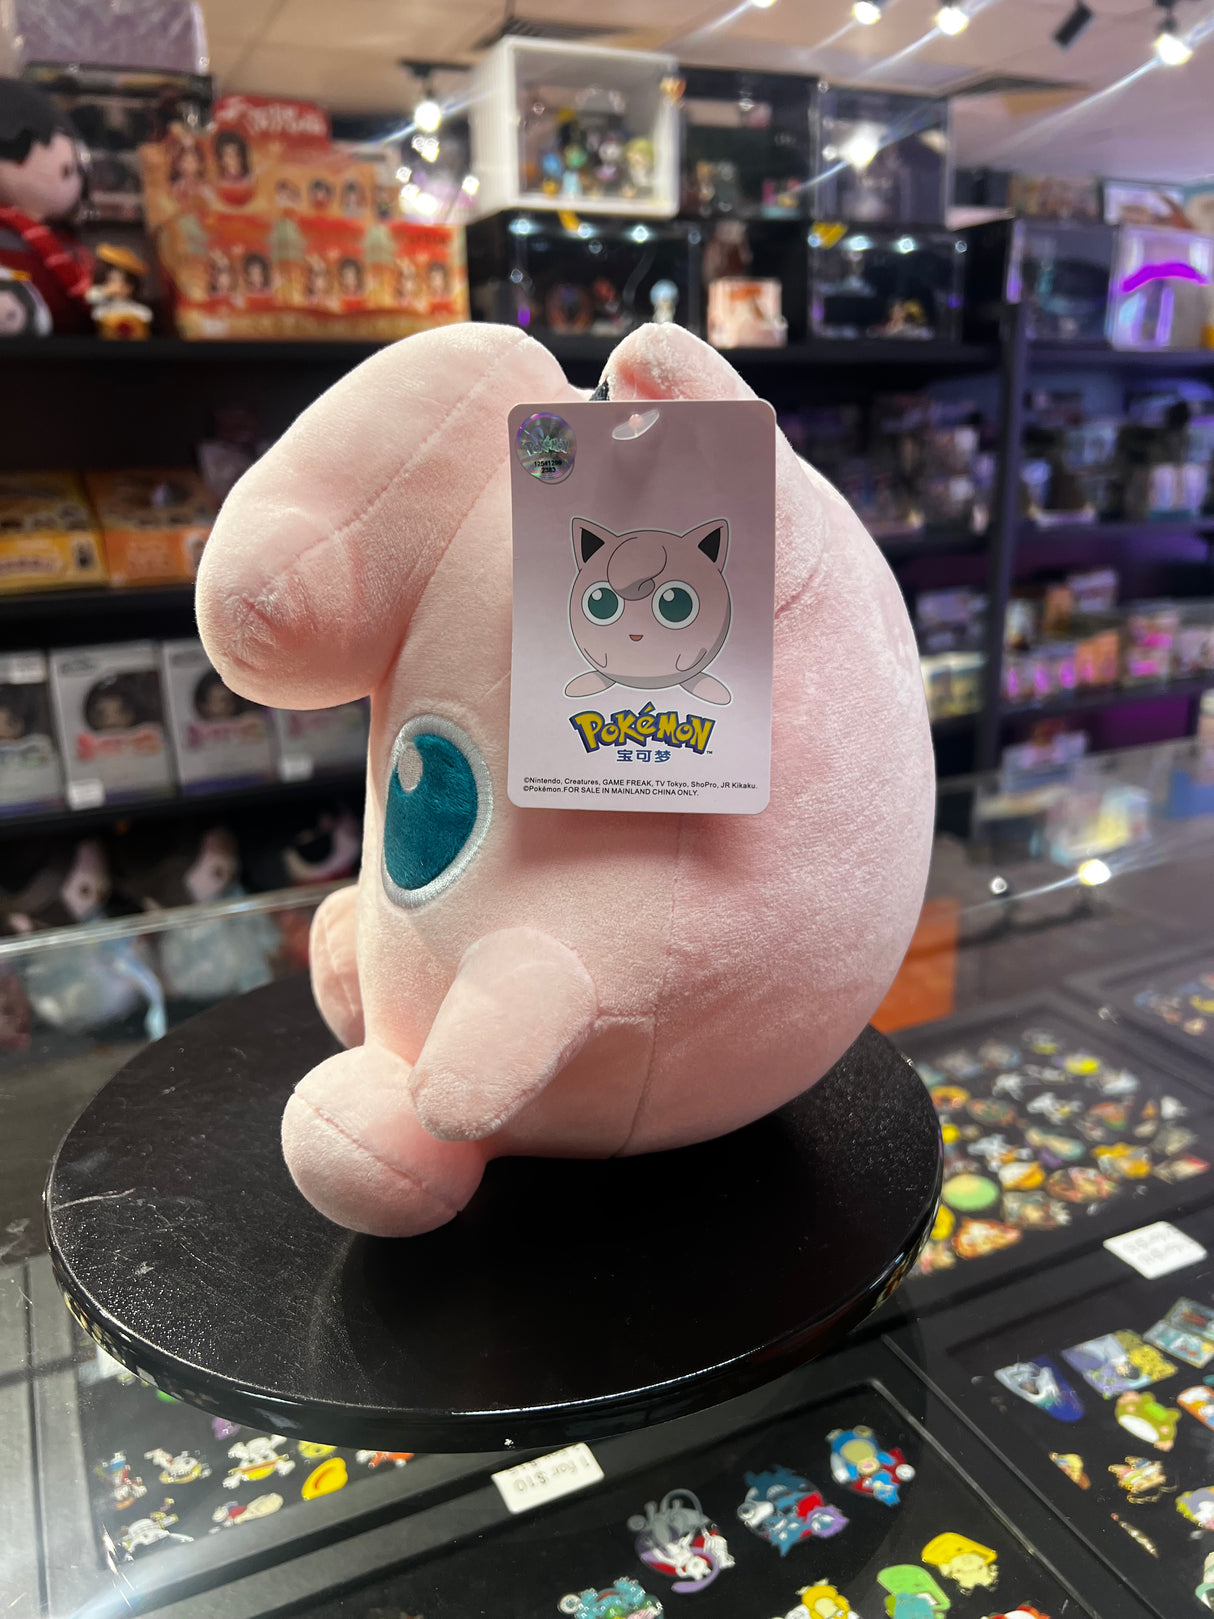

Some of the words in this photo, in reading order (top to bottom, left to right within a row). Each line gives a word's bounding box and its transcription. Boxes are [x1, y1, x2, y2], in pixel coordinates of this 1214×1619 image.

[616, 750, 671, 763] 宝可梦
[564, 778, 601, 786] Creatures,
[626, 779, 654, 787] FREAK,
[667, 780, 689, 788] Tokyo,
[691, 781, 719, 789] ShoPro,
[581, 786, 600, 794] SALE
[611, 787, 651, 795] MAINLAND
[652, 788, 676, 796] CHINA
